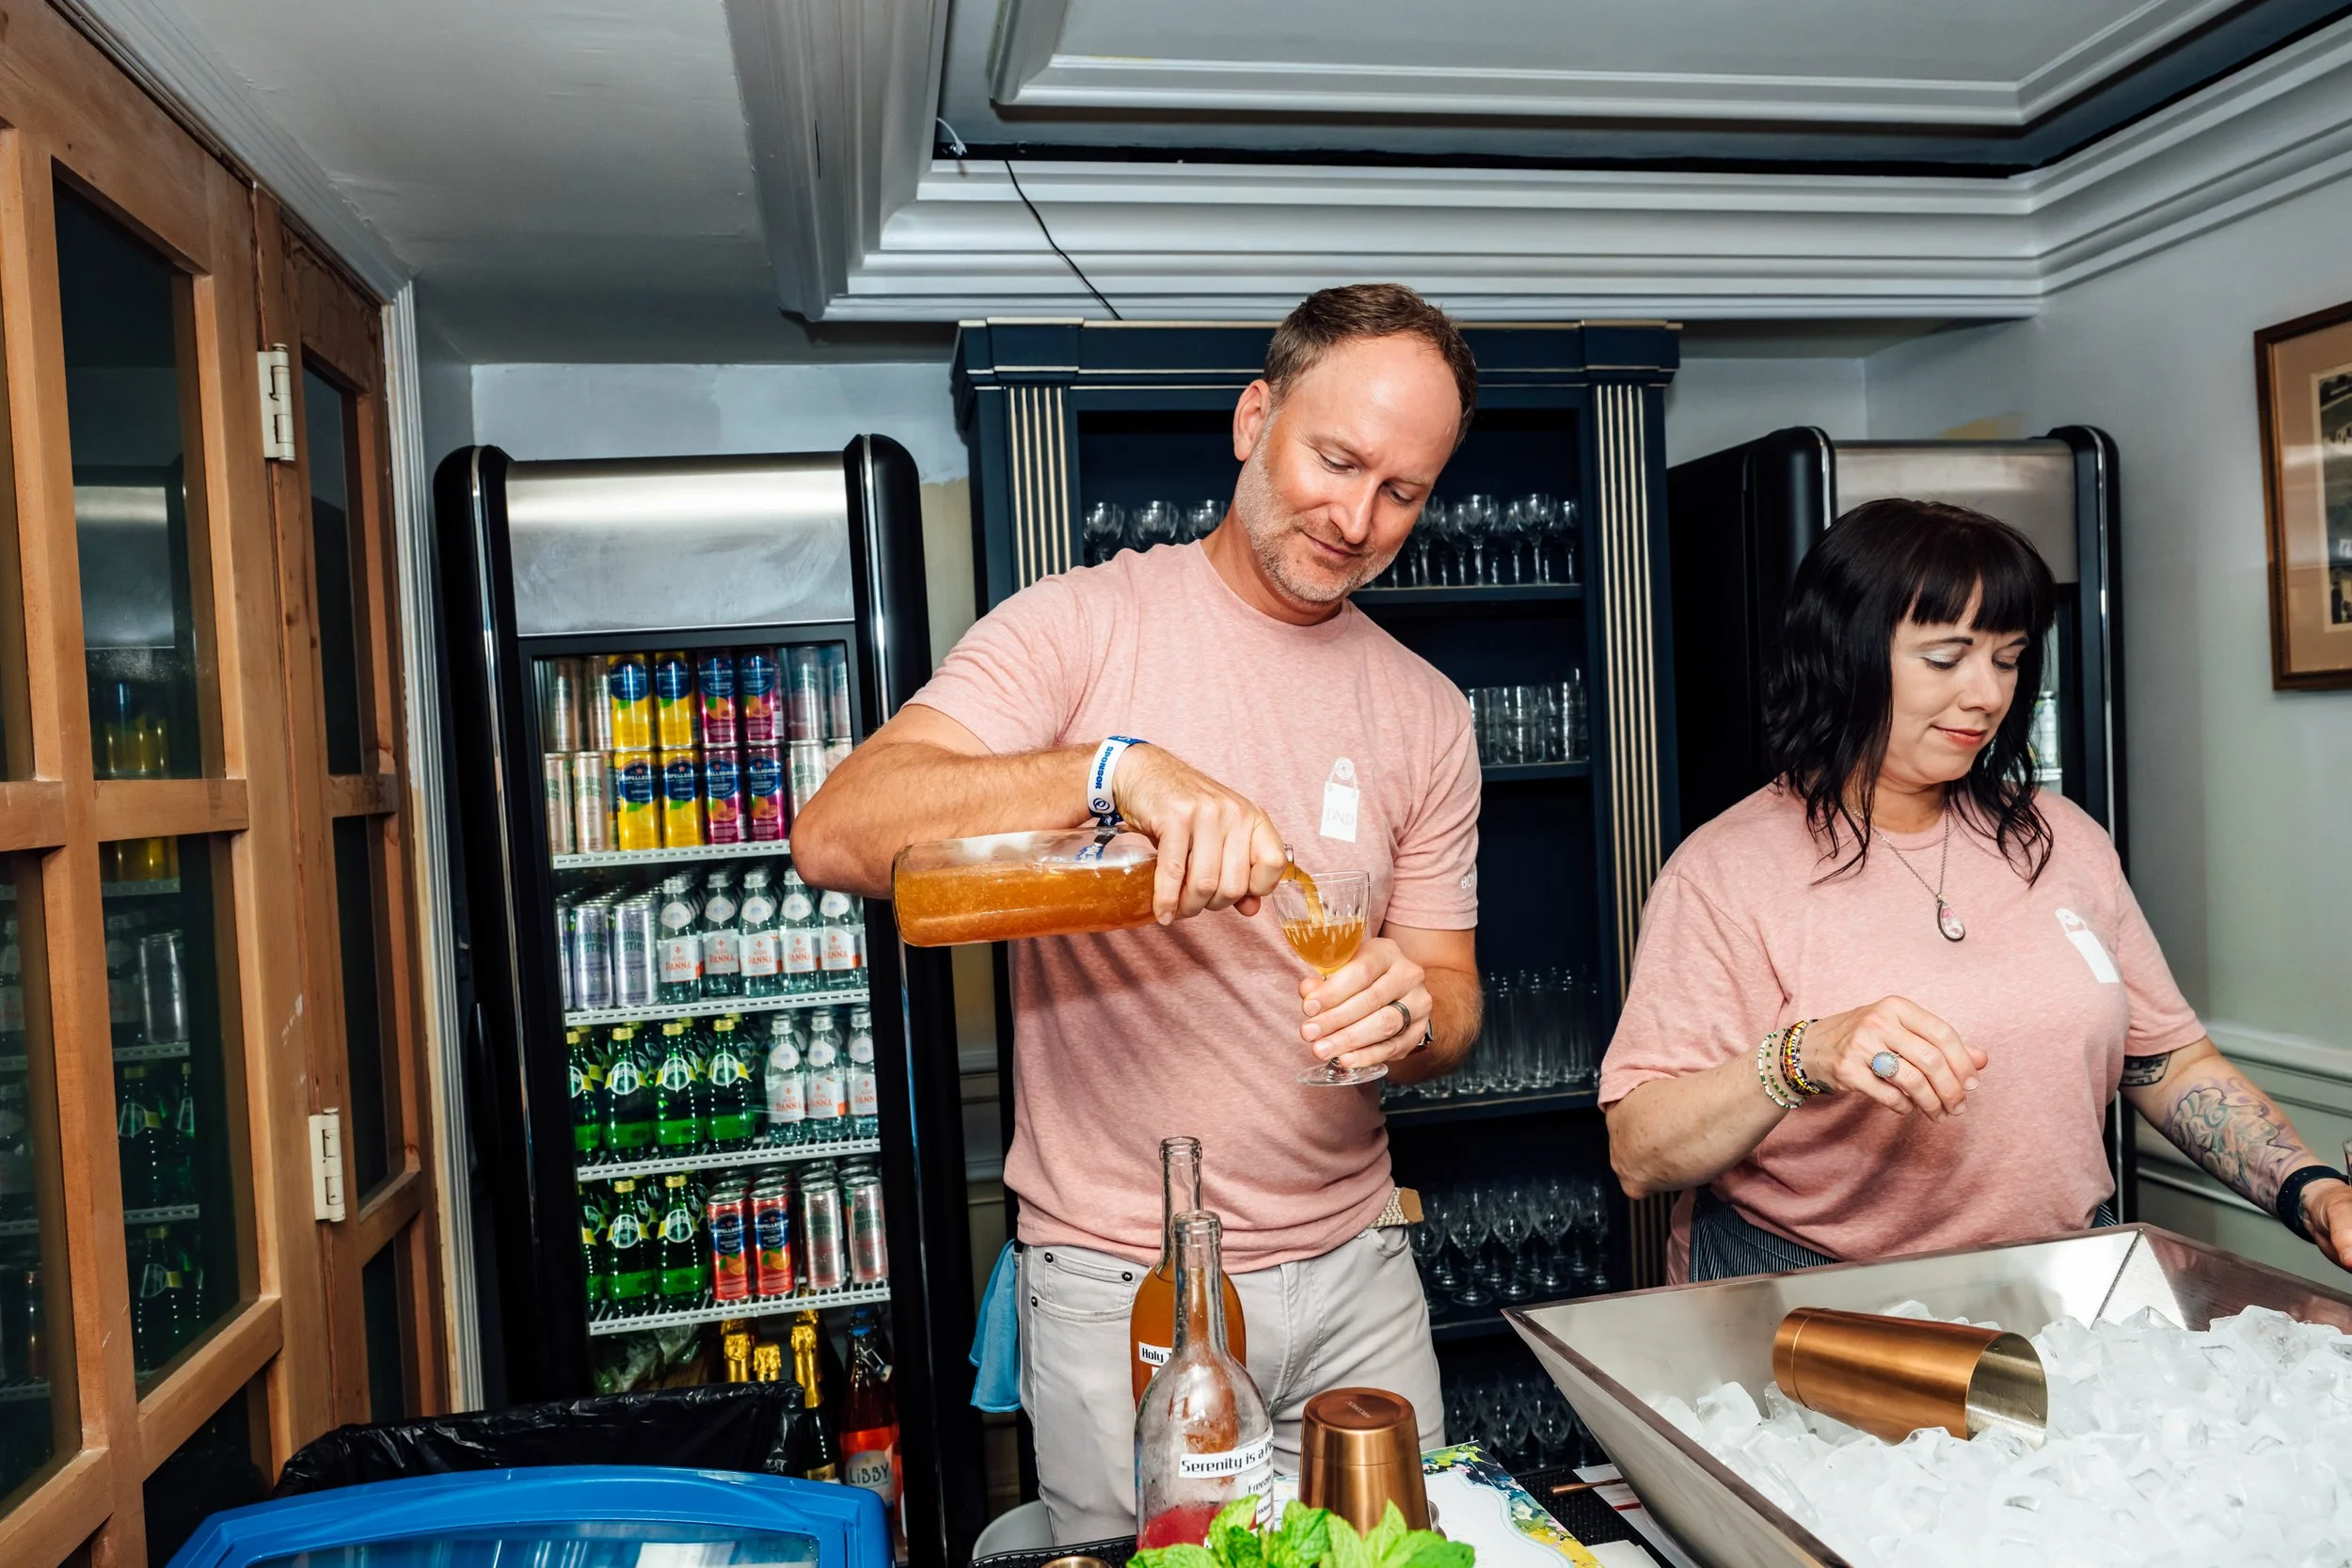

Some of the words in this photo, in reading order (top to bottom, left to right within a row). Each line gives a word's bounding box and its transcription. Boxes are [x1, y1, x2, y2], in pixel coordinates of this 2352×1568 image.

[1095, 746, 1114, 789] SPONSOR
[1327, 808, 1355, 826] DND
[708, 954, 735, 964] PANNA
[748, 955, 772, 965] PANNA
[665, 961, 691, 971] PANNA
[854, 1094, 875, 1104] PANN
[1141, 1347, 1164, 1364] Holy
[1182, 1457, 1242, 1473] Serenity
[1246, 1452, 1256, 1465] is
[1258, 1448, 1264, 1460] a
